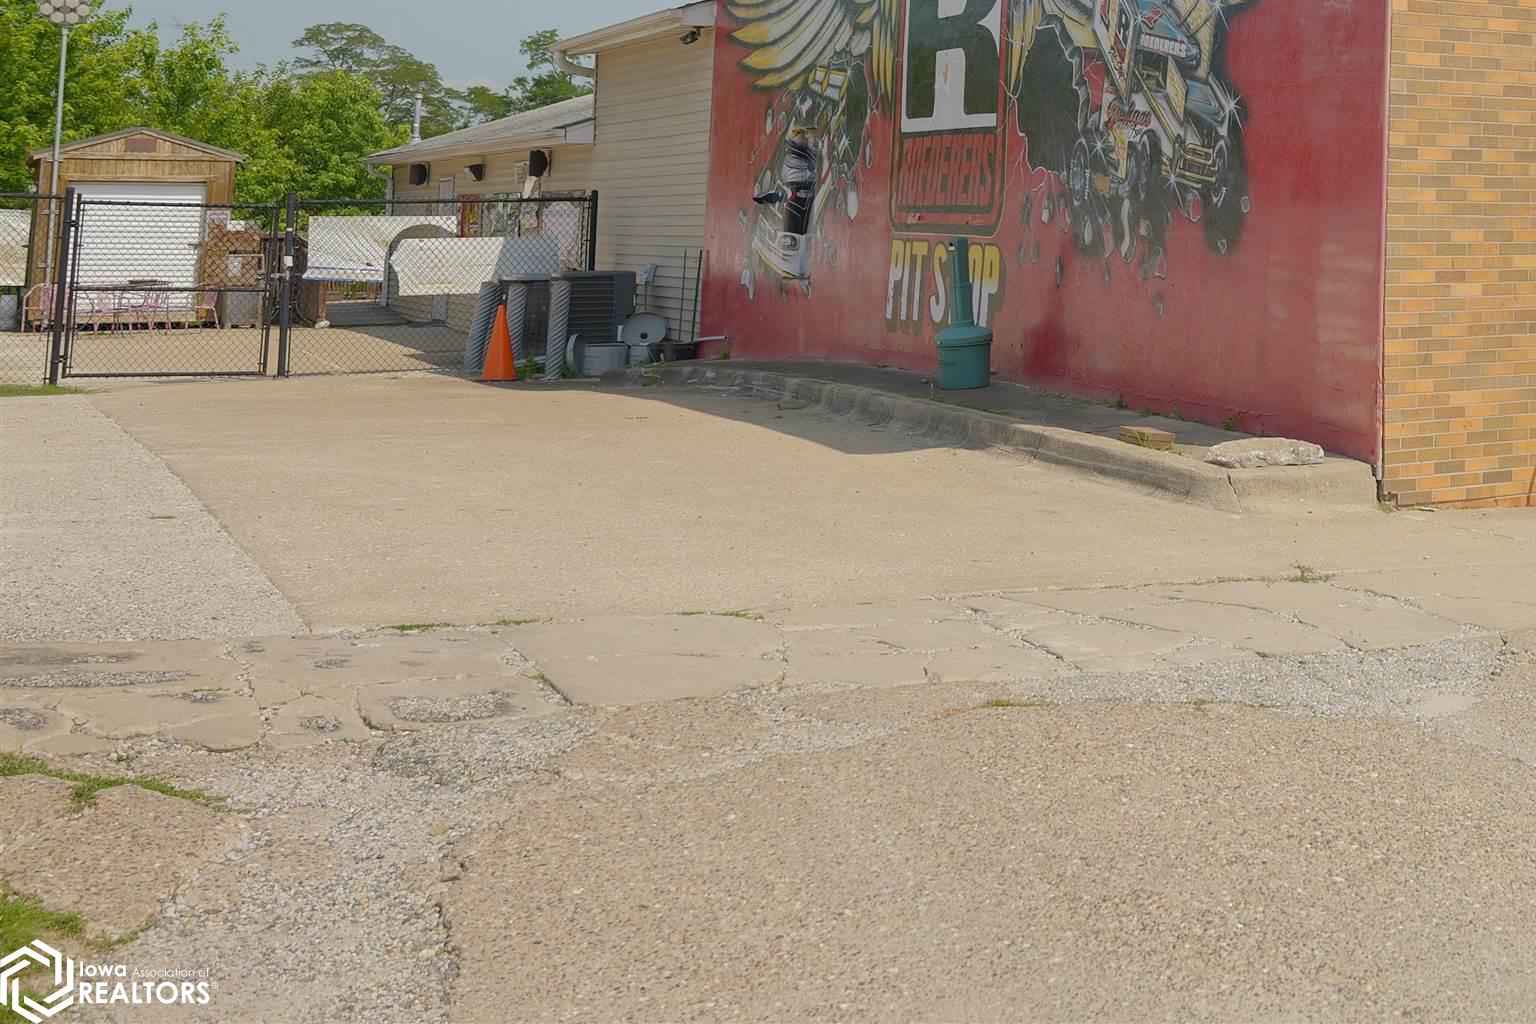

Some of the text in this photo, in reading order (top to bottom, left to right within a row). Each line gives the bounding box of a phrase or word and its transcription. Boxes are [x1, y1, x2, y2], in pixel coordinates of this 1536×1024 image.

[896, 134, 994, 207] ROEDERERS
[886, 239, 1000, 327] PIT SOP
